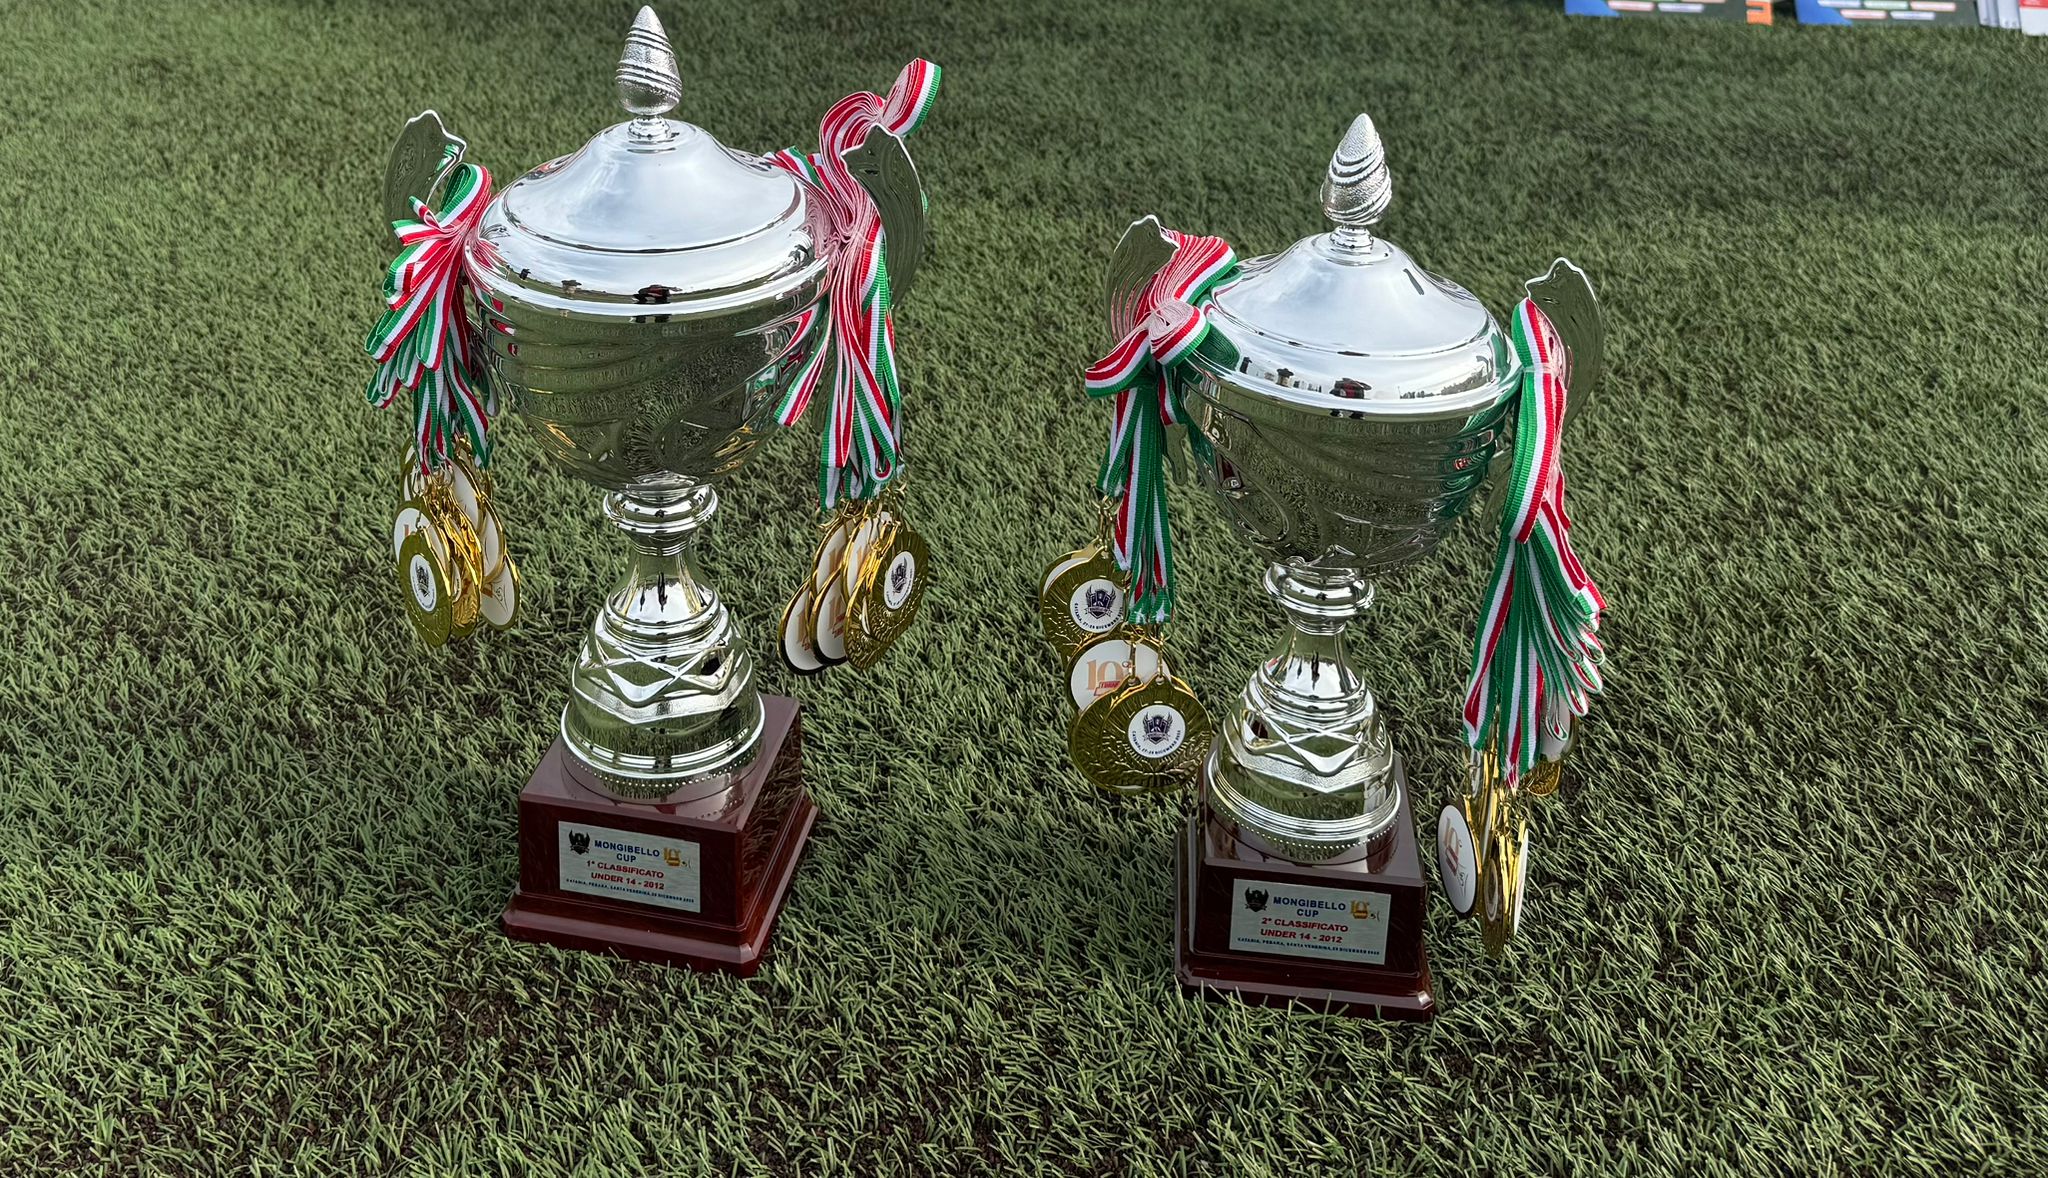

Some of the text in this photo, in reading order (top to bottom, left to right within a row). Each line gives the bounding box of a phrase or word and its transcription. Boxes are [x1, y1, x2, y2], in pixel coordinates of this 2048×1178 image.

[594, 840, 660, 858] MONGIBELLO
[616, 853, 637, 863] CUP
[597, 862, 664, 879] CLASSIFICATO
[591, 872, 624, 884] UNDER
[626, 877, 637, 885] 14
[643, 880, 665, 890] 2012
[1273, 896, 1346, 911] MONGIBELLO
[1296, 908, 1319, 918] CUP
[1274, 918, 1349, 933] CLASSIFICATO
[1260, 928, 1296, 939] UNDER
[1299, 932, 1311, 941] 14
[1319, 935, 1343, 944] 2012
